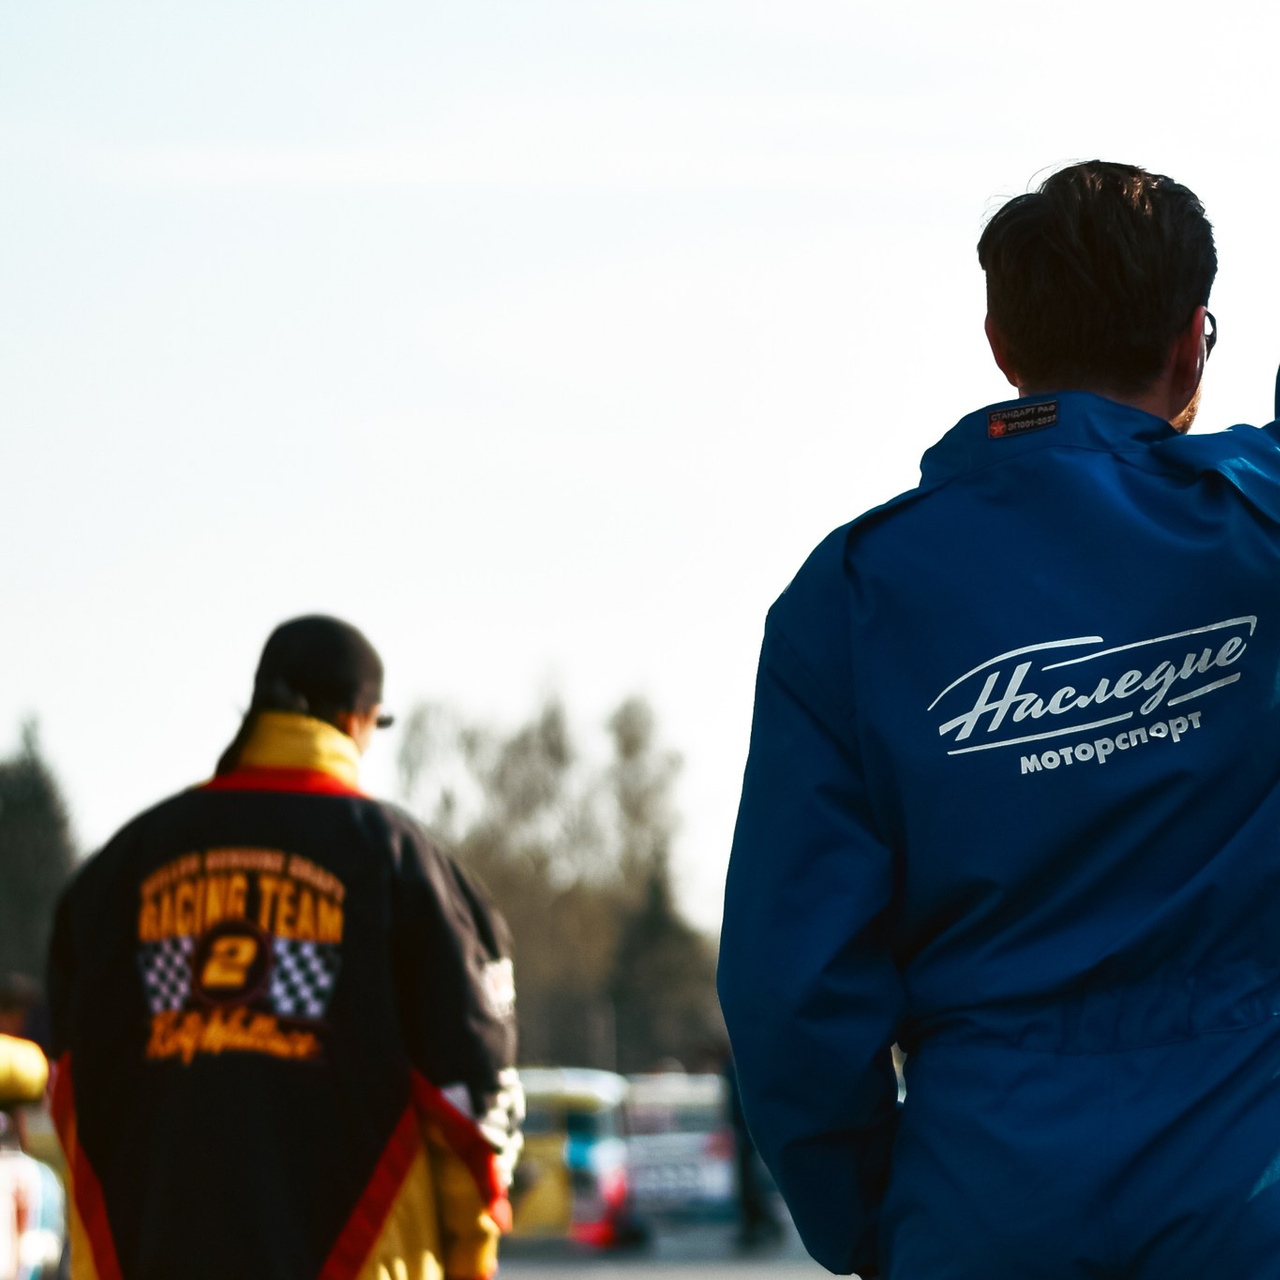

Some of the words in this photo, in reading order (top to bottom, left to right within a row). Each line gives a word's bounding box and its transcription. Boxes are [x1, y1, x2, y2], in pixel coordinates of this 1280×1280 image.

[991, 408, 1036, 420] СТАНДАРТ
[939, 636, 1248, 742] Наследие
[1020, 710, 1202, 775] моторспорт
[258, 875, 344, 945] TEAM
[202, 935, 258, 988] 2
